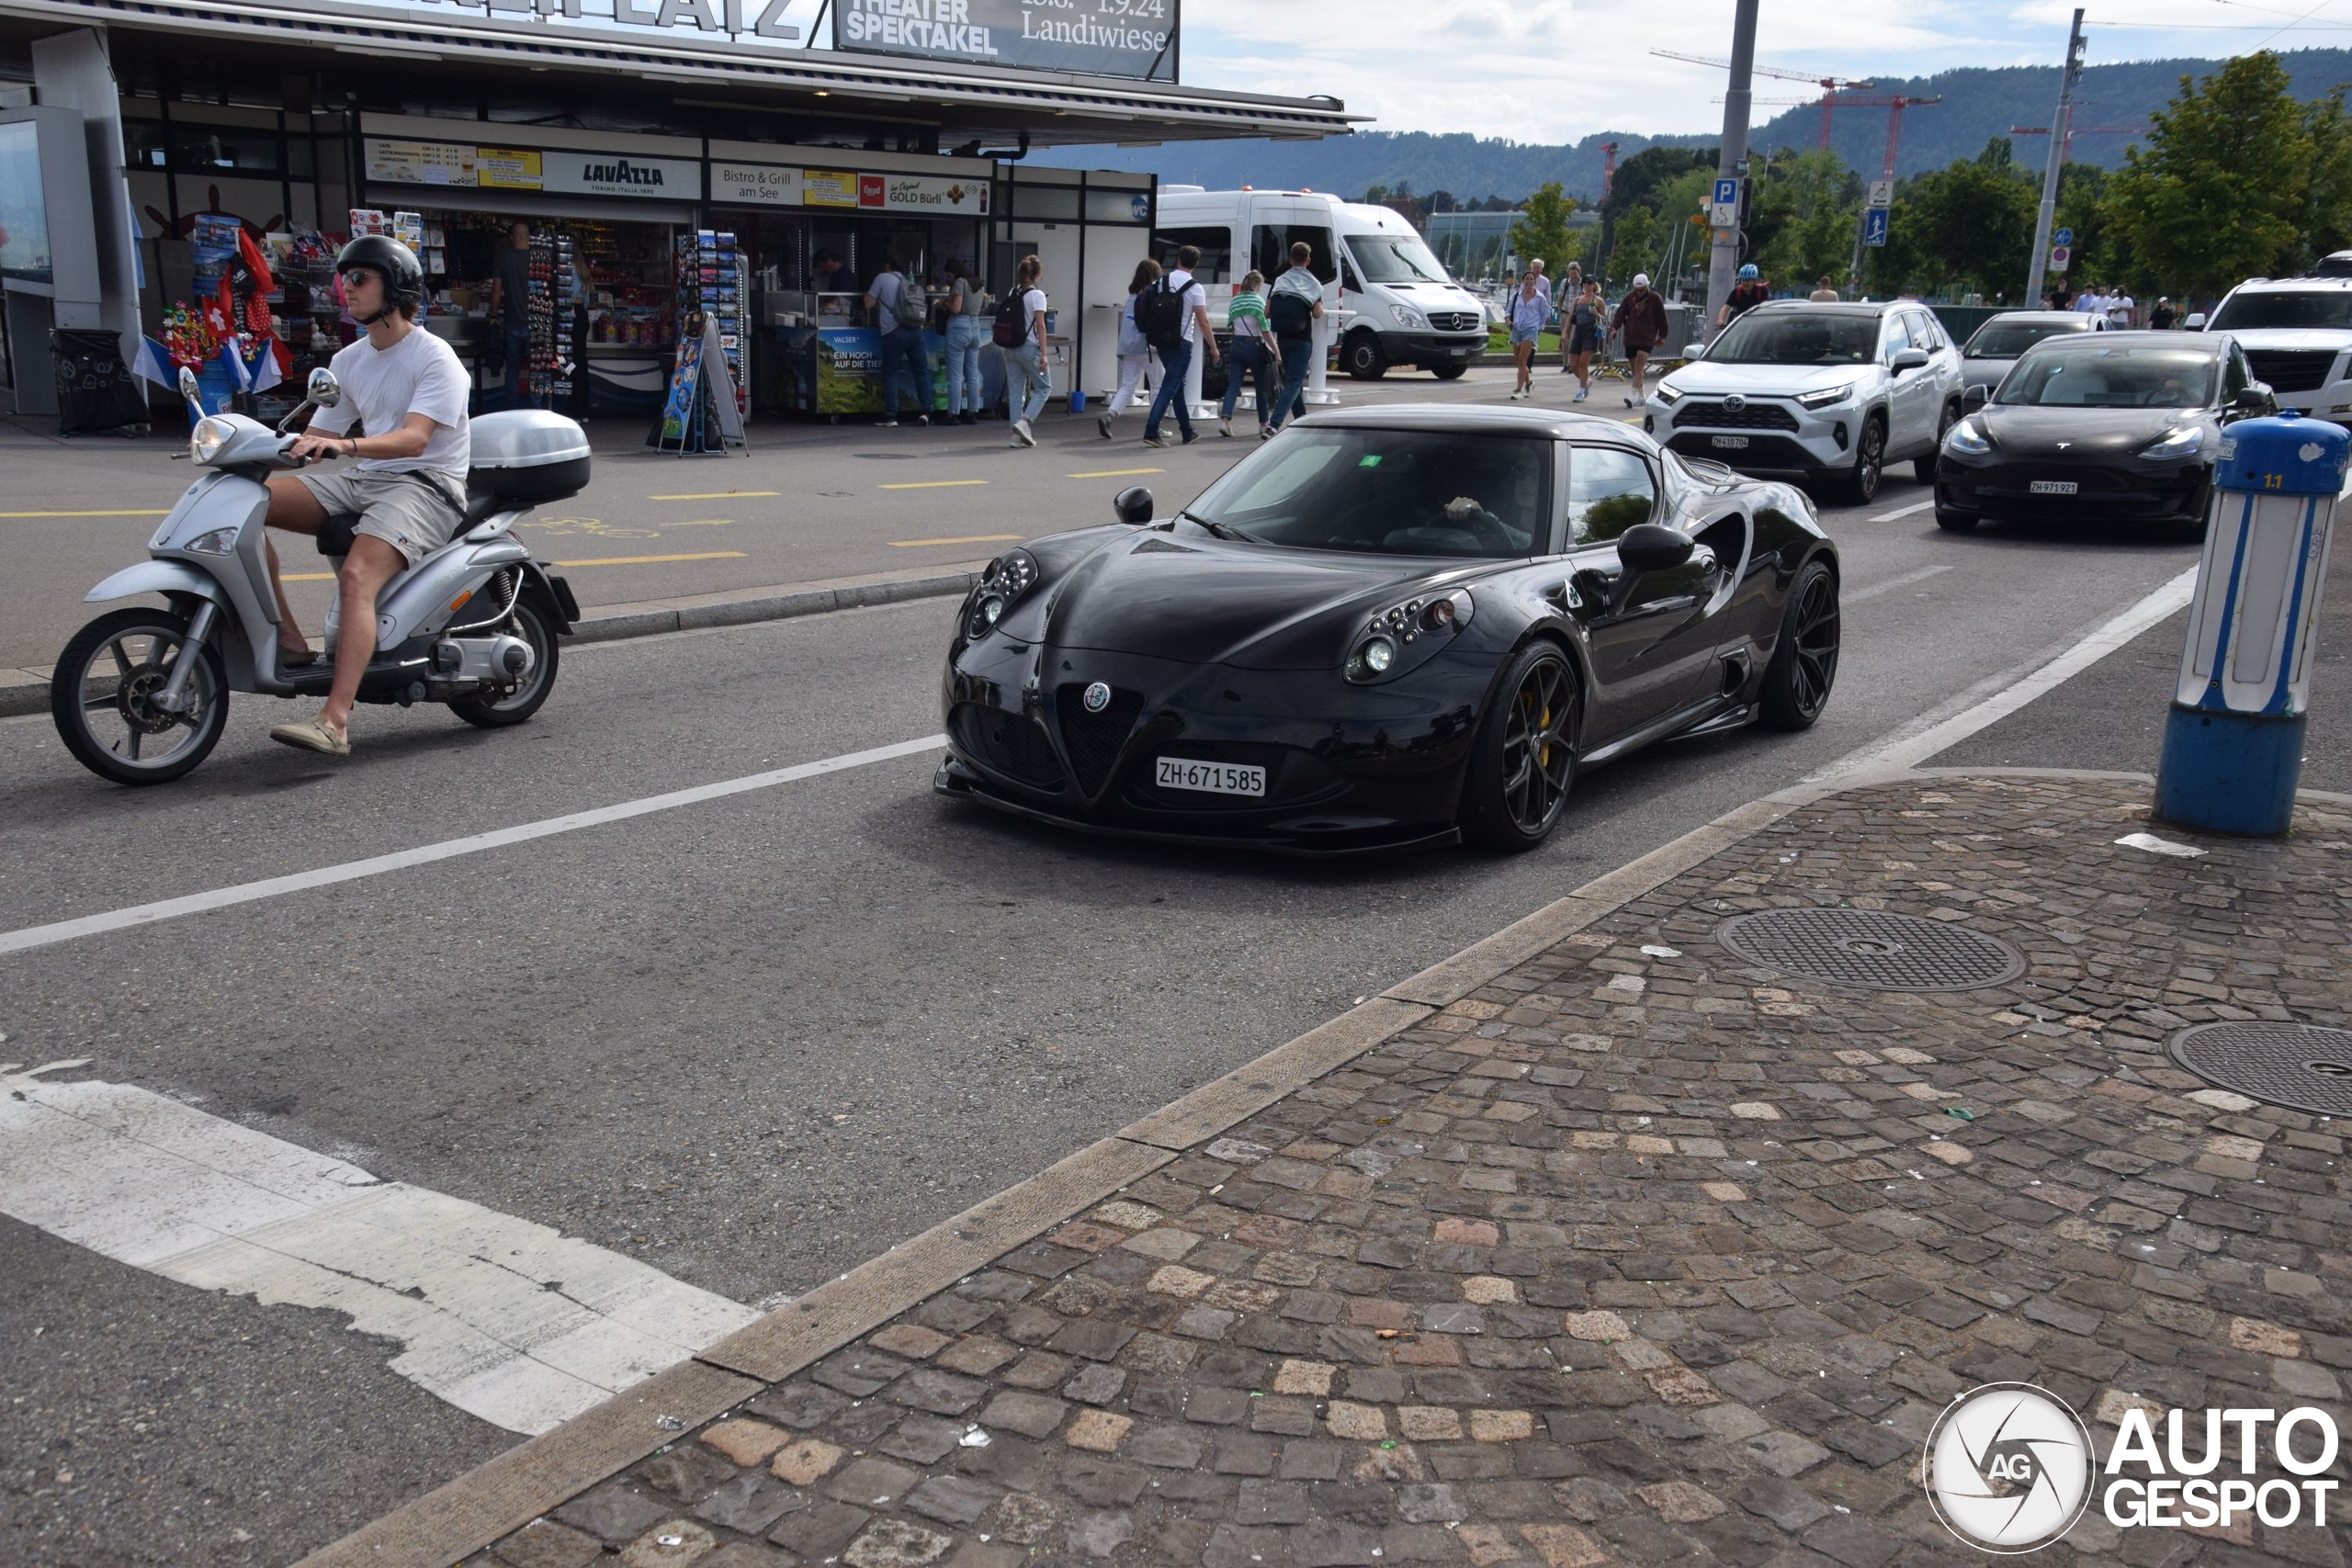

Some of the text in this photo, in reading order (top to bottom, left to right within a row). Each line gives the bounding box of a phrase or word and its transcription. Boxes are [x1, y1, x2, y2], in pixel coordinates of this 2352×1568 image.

[847, 11, 999, 55] SPEKTAKEL
[1022, 11, 1167, 52] Landiwiese
[582, 159, 664, 186] LAVAZZA
[724, 170, 791, 185] Bistro & Grill
[739, 186, 779, 198] am See
[889, 192, 942, 204] GOLD Bürli
[1720, 184, 1732, 201] P
[1132, 205, 1148, 217] WC
[833, 351, 873, 360] EIN HOCH
[834, 359, 884, 368] AUF DIE TIEF
